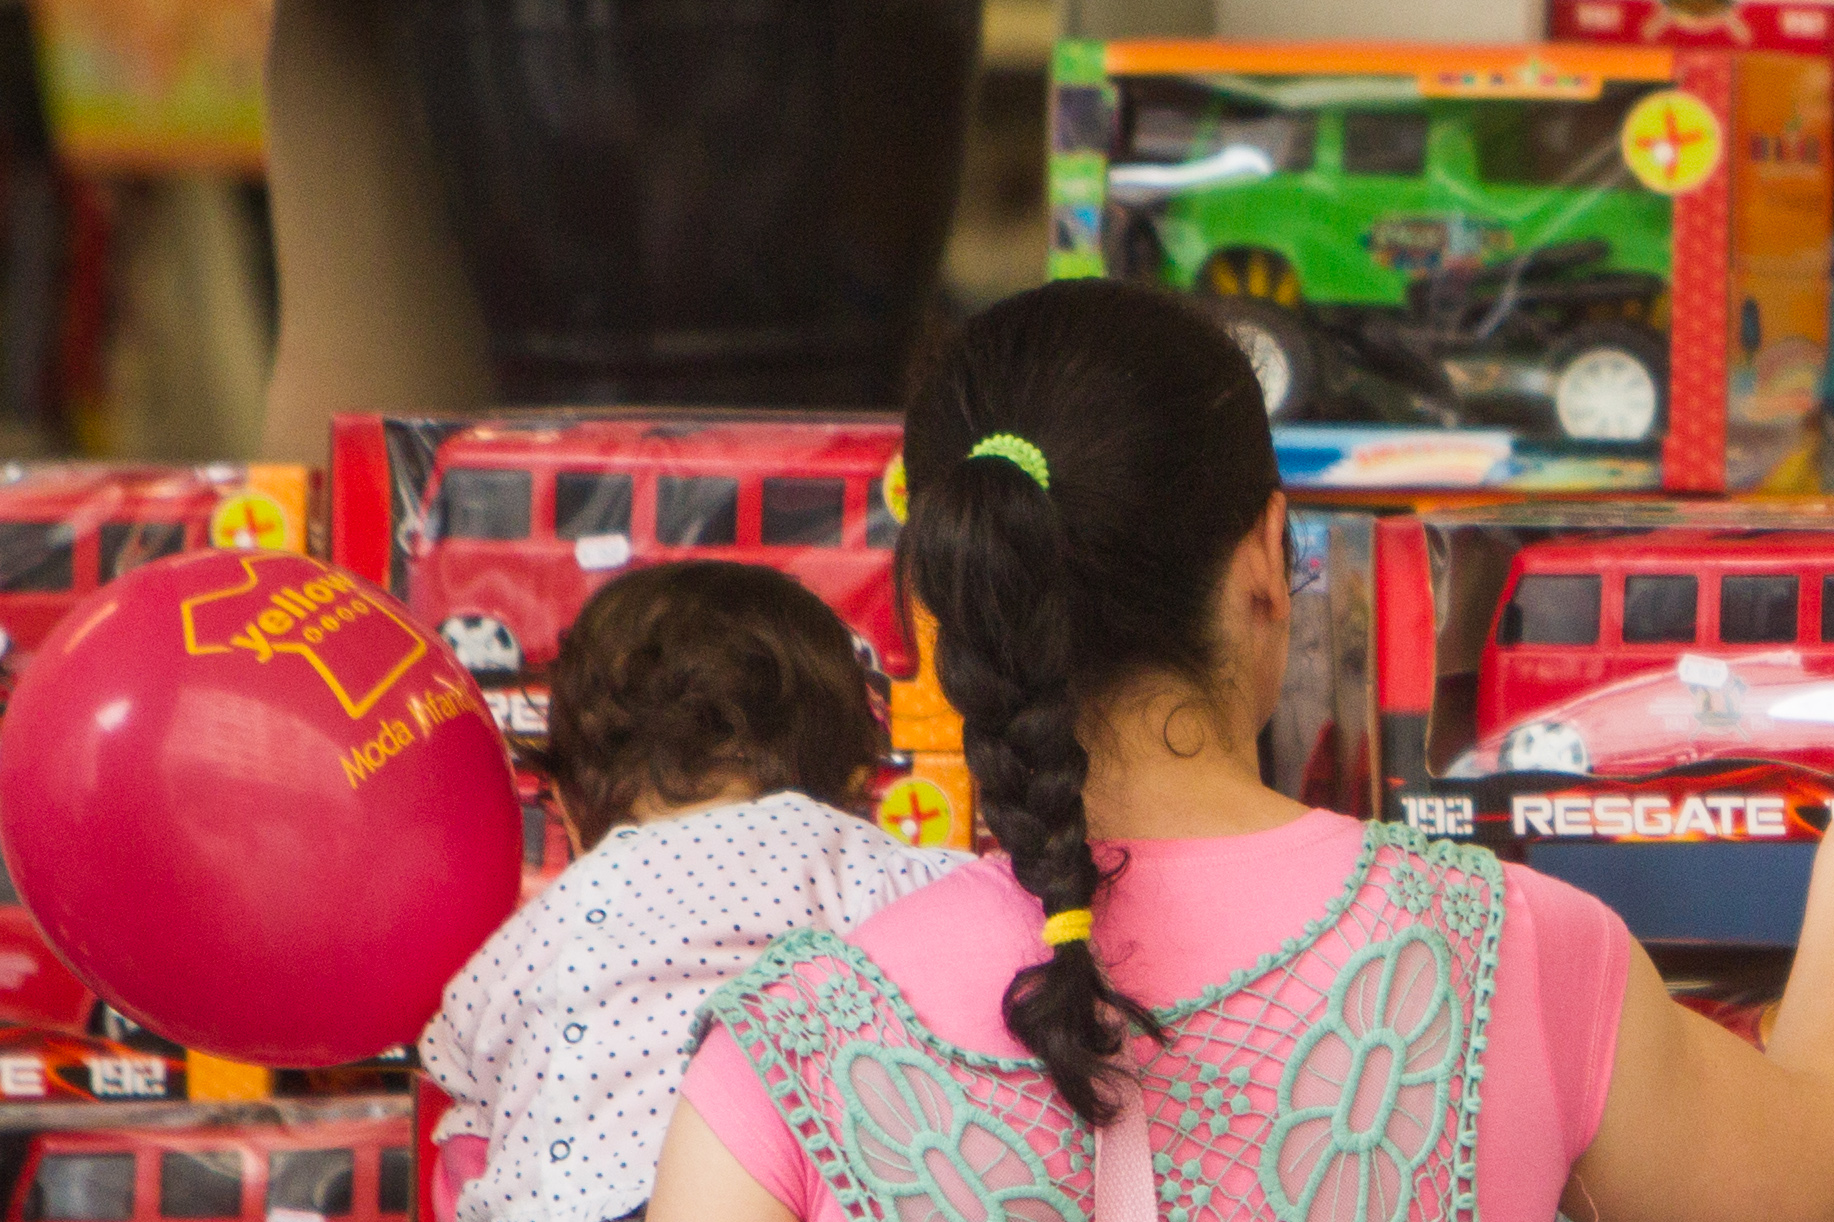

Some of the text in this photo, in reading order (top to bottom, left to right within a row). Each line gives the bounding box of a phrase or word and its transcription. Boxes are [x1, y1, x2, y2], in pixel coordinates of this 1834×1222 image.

[230, 570, 355, 664] yellow
[338, 718, 416, 791] Moda
[1400, 795, 1474, 836] 192
[1511, 795, 1789, 837] RESGATE
[84, 1055, 168, 1097] 192
